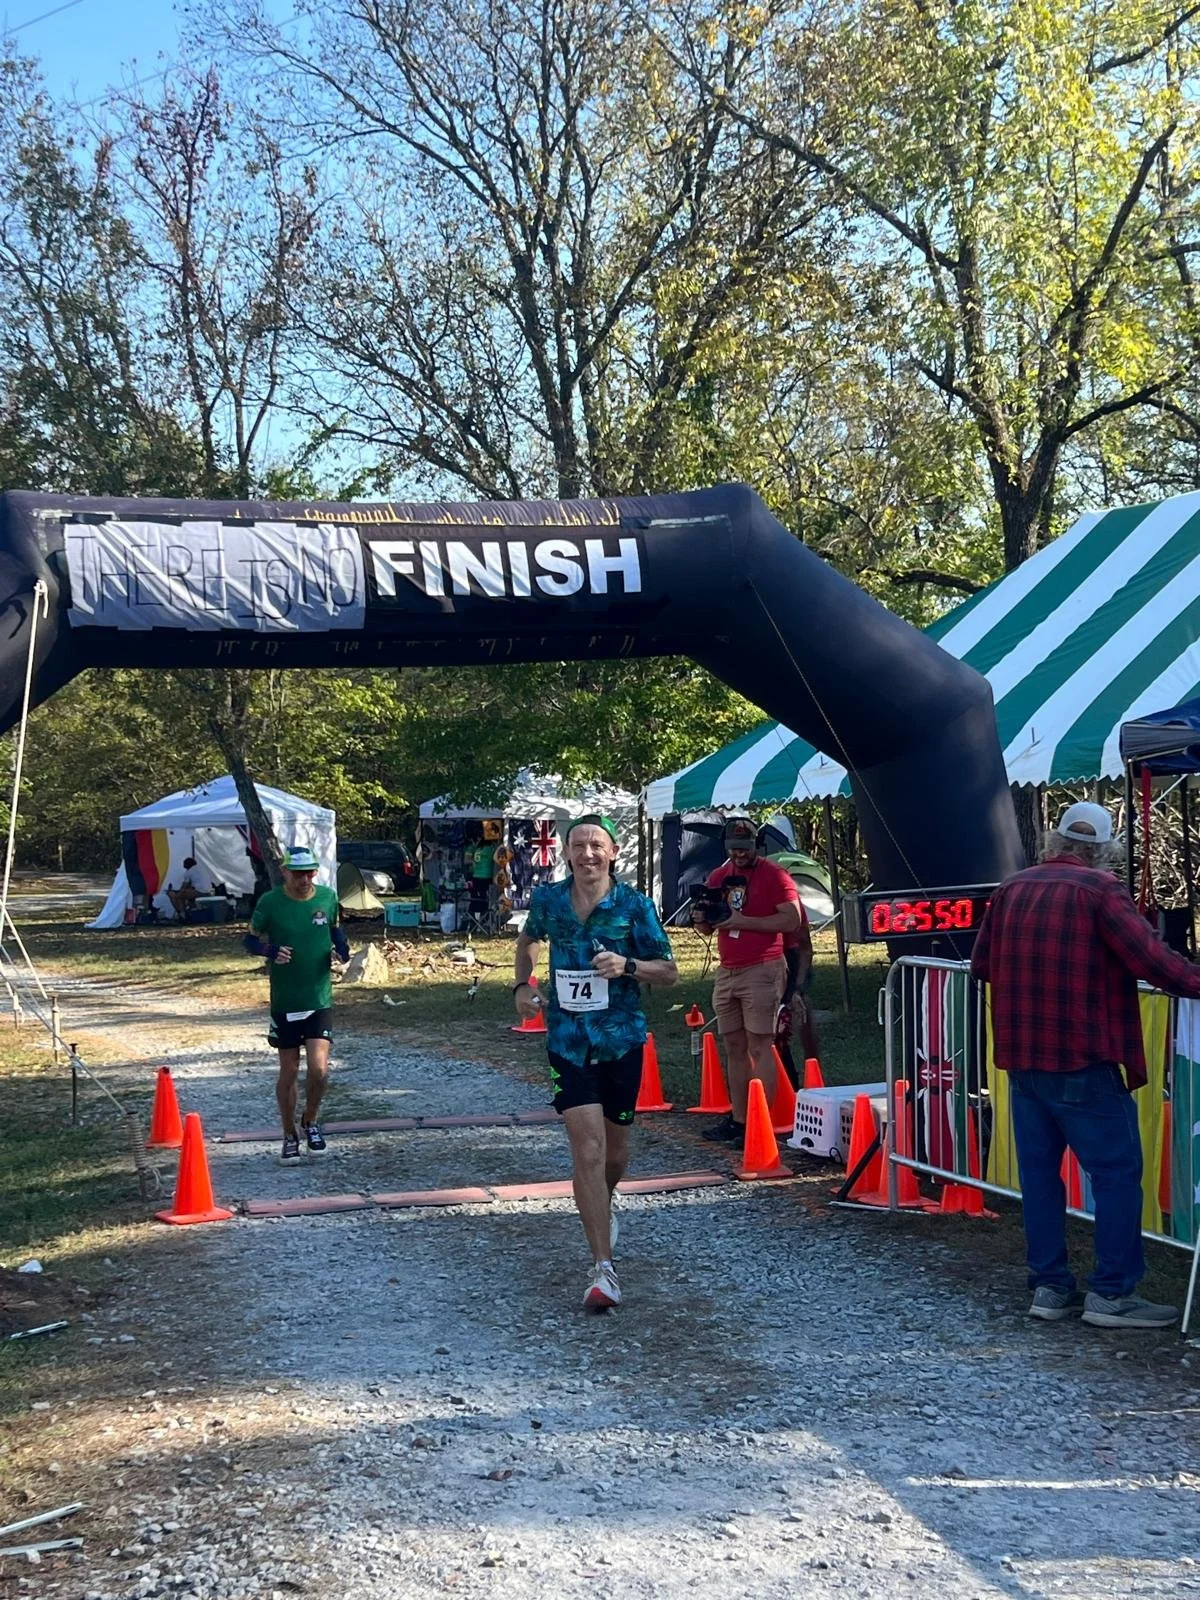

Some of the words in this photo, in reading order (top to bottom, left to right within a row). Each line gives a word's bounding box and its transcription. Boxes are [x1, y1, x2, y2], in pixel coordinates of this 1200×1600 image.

[67, 535, 230, 613] THERE
[238, 558, 293, 619] IS
[300, 545, 358, 608] NO
[369, 537, 642, 599] FINISH
[569, 982, 592, 999] 74
